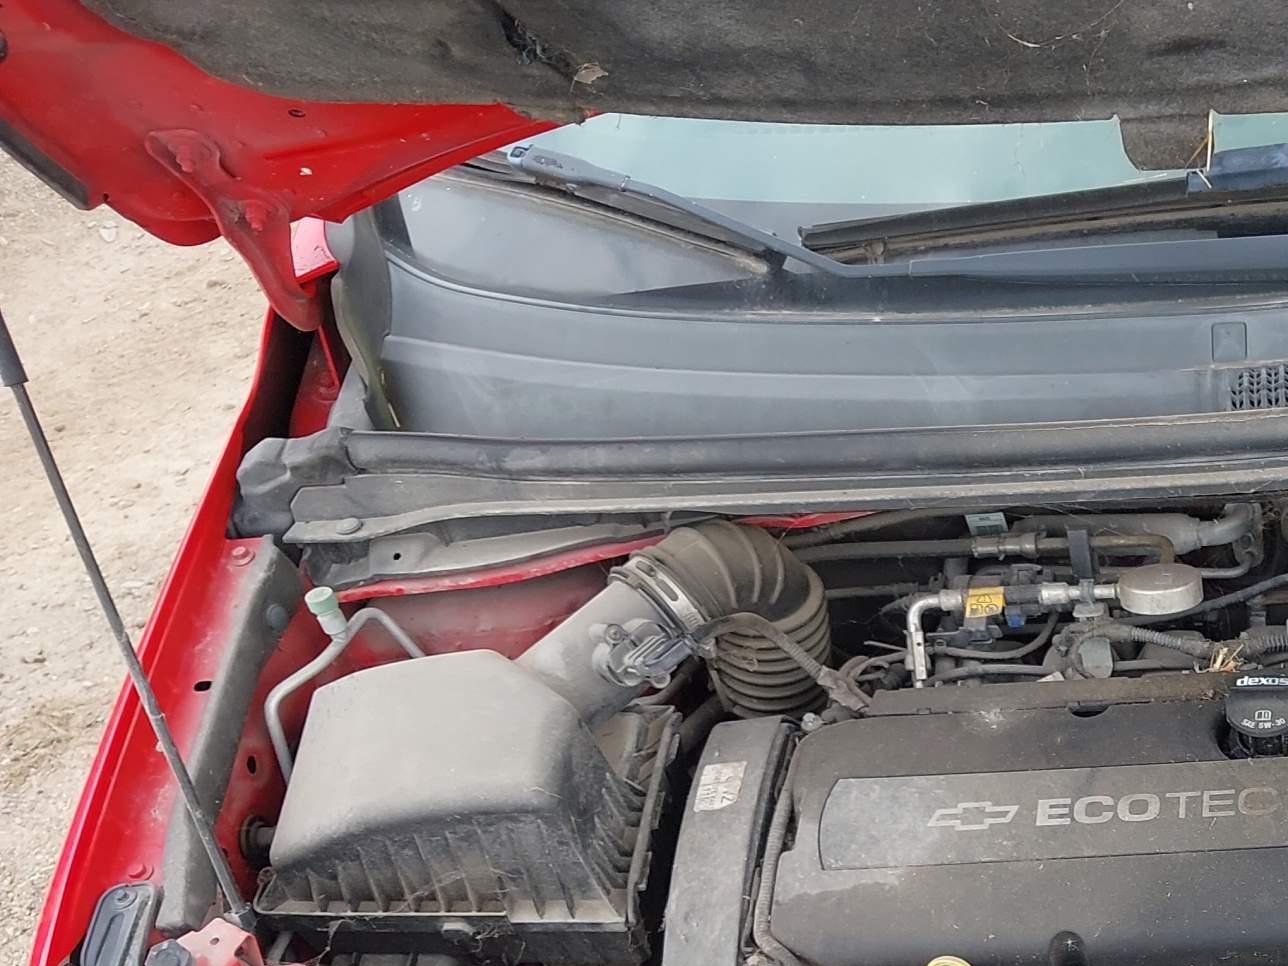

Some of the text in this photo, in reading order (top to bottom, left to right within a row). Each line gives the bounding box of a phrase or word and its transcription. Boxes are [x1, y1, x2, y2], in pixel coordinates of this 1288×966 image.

[1241, 717, 1287, 729] SAE 5W-30
[1035, 786, 1280, 827] ECOTEC
